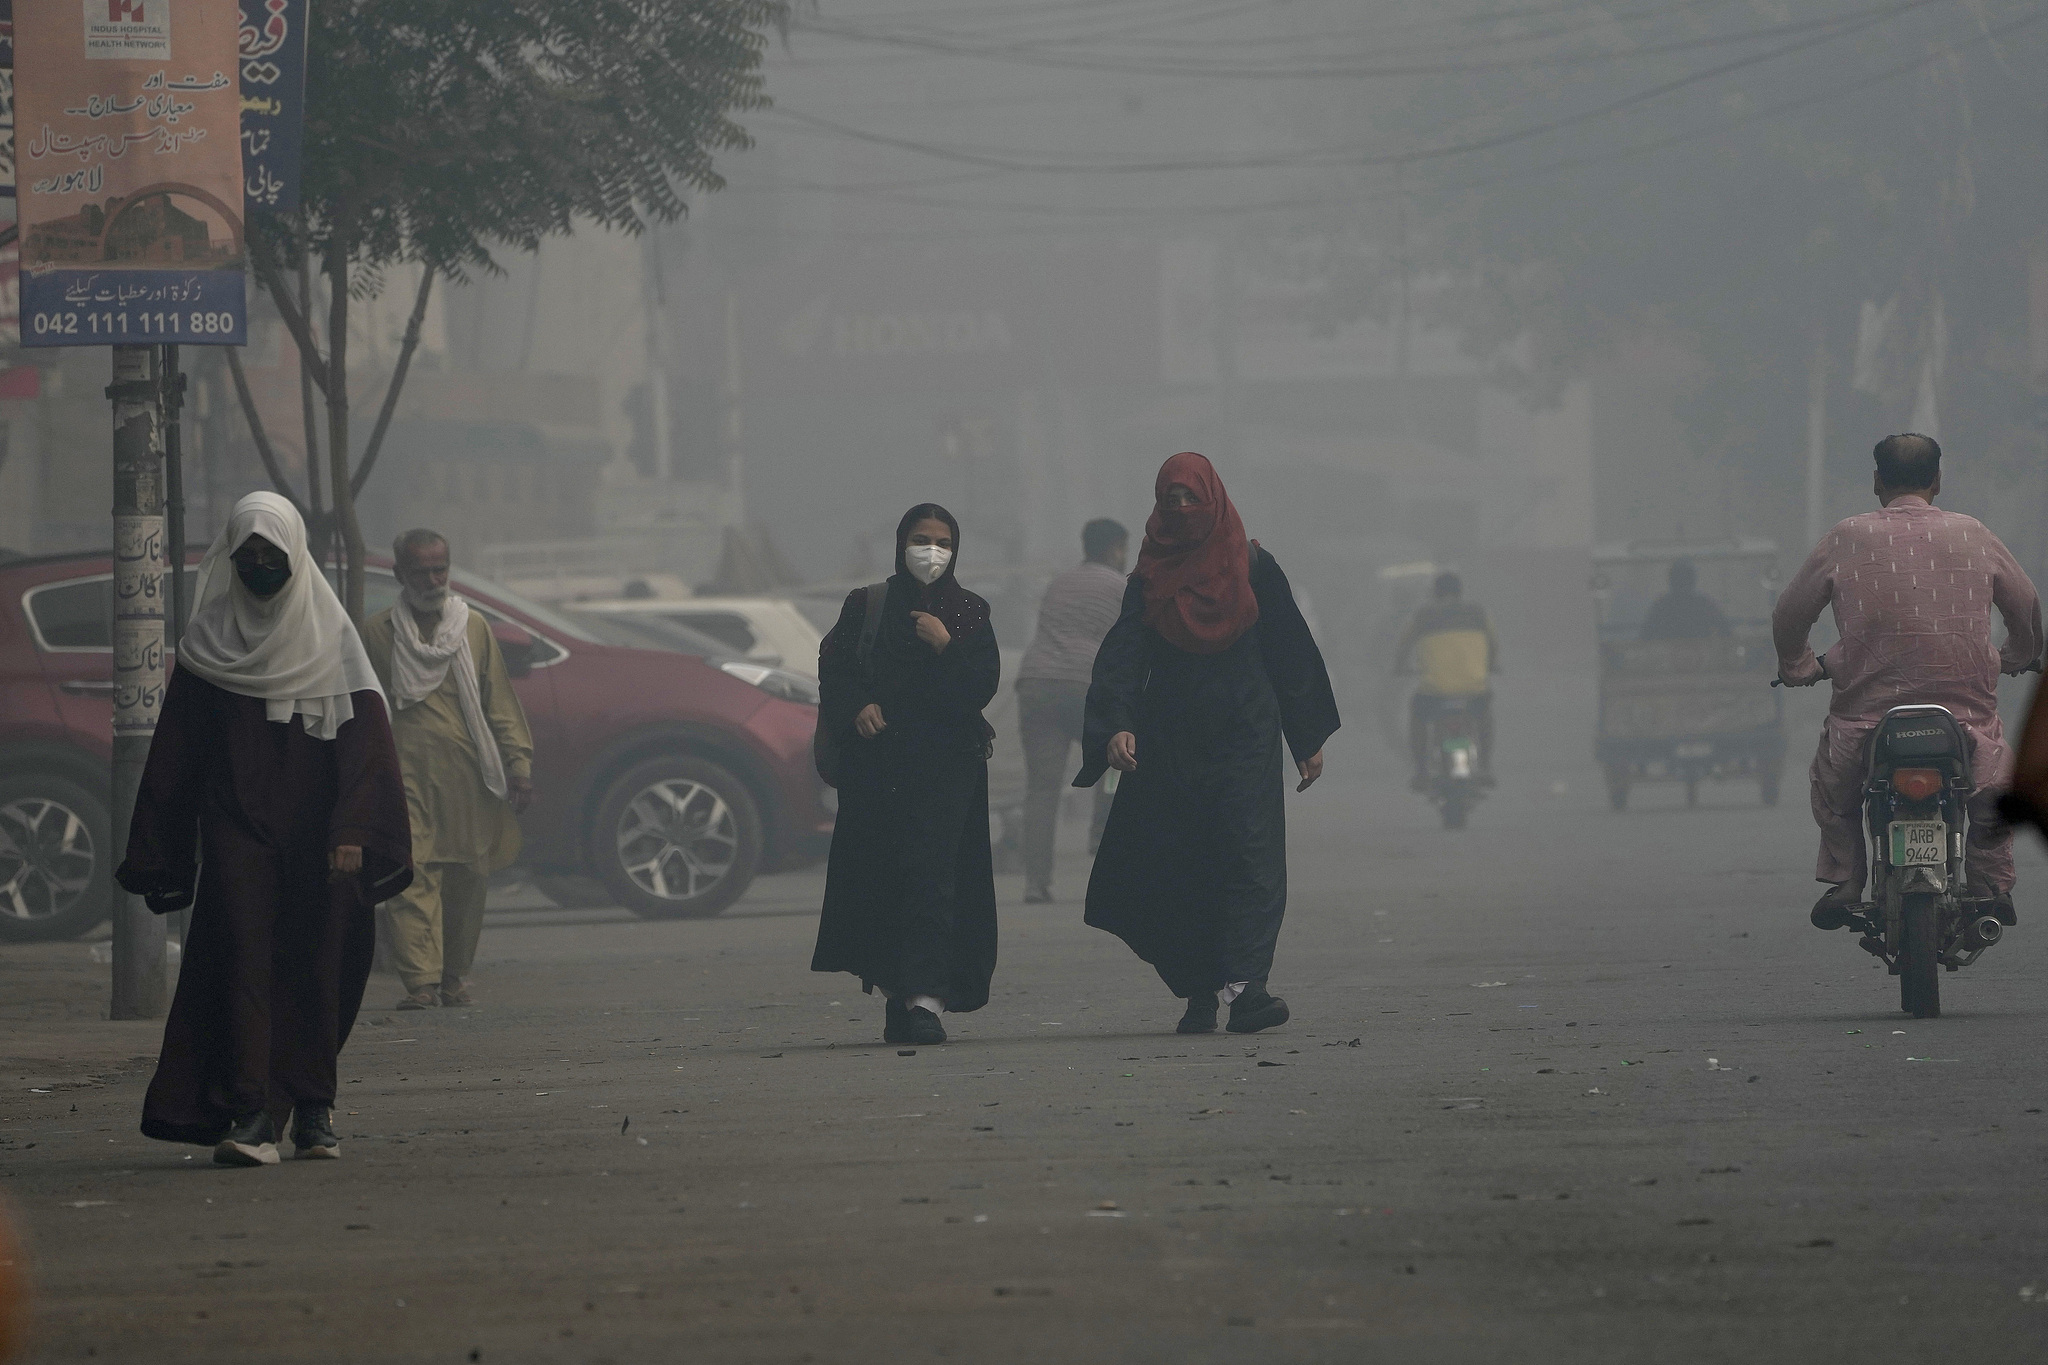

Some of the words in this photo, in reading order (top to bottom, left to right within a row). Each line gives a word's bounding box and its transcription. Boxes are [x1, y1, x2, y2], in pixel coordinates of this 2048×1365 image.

[91, 25, 118, 33] INDUS
[120, 25, 162, 34] HOSPITAL
[88, 40, 122, 48] HEALTH
[123, 40, 166, 49] NETWORK
[144, 71, 164, 89] اور
[166, 72, 230, 90] مفت
[148, 95, 193, 122] معیاری
[30, 126, 106, 161] ہسپتال
[108, 127, 180, 158] انڈس
[47, 164, 103, 193] لاہور
[94, 283, 148, 307] عطیات
[147, 284, 167, 302] اور
[34, 312, 78, 334] 042
[87, 312, 128, 334] 111
[139, 312, 180, 334] 111
[190, 312, 234, 334] 880
[1895, 728, 1946, 739] HONDA
[1909, 829, 1934, 844] ARB
[1905, 847, 1938, 862] 9442
